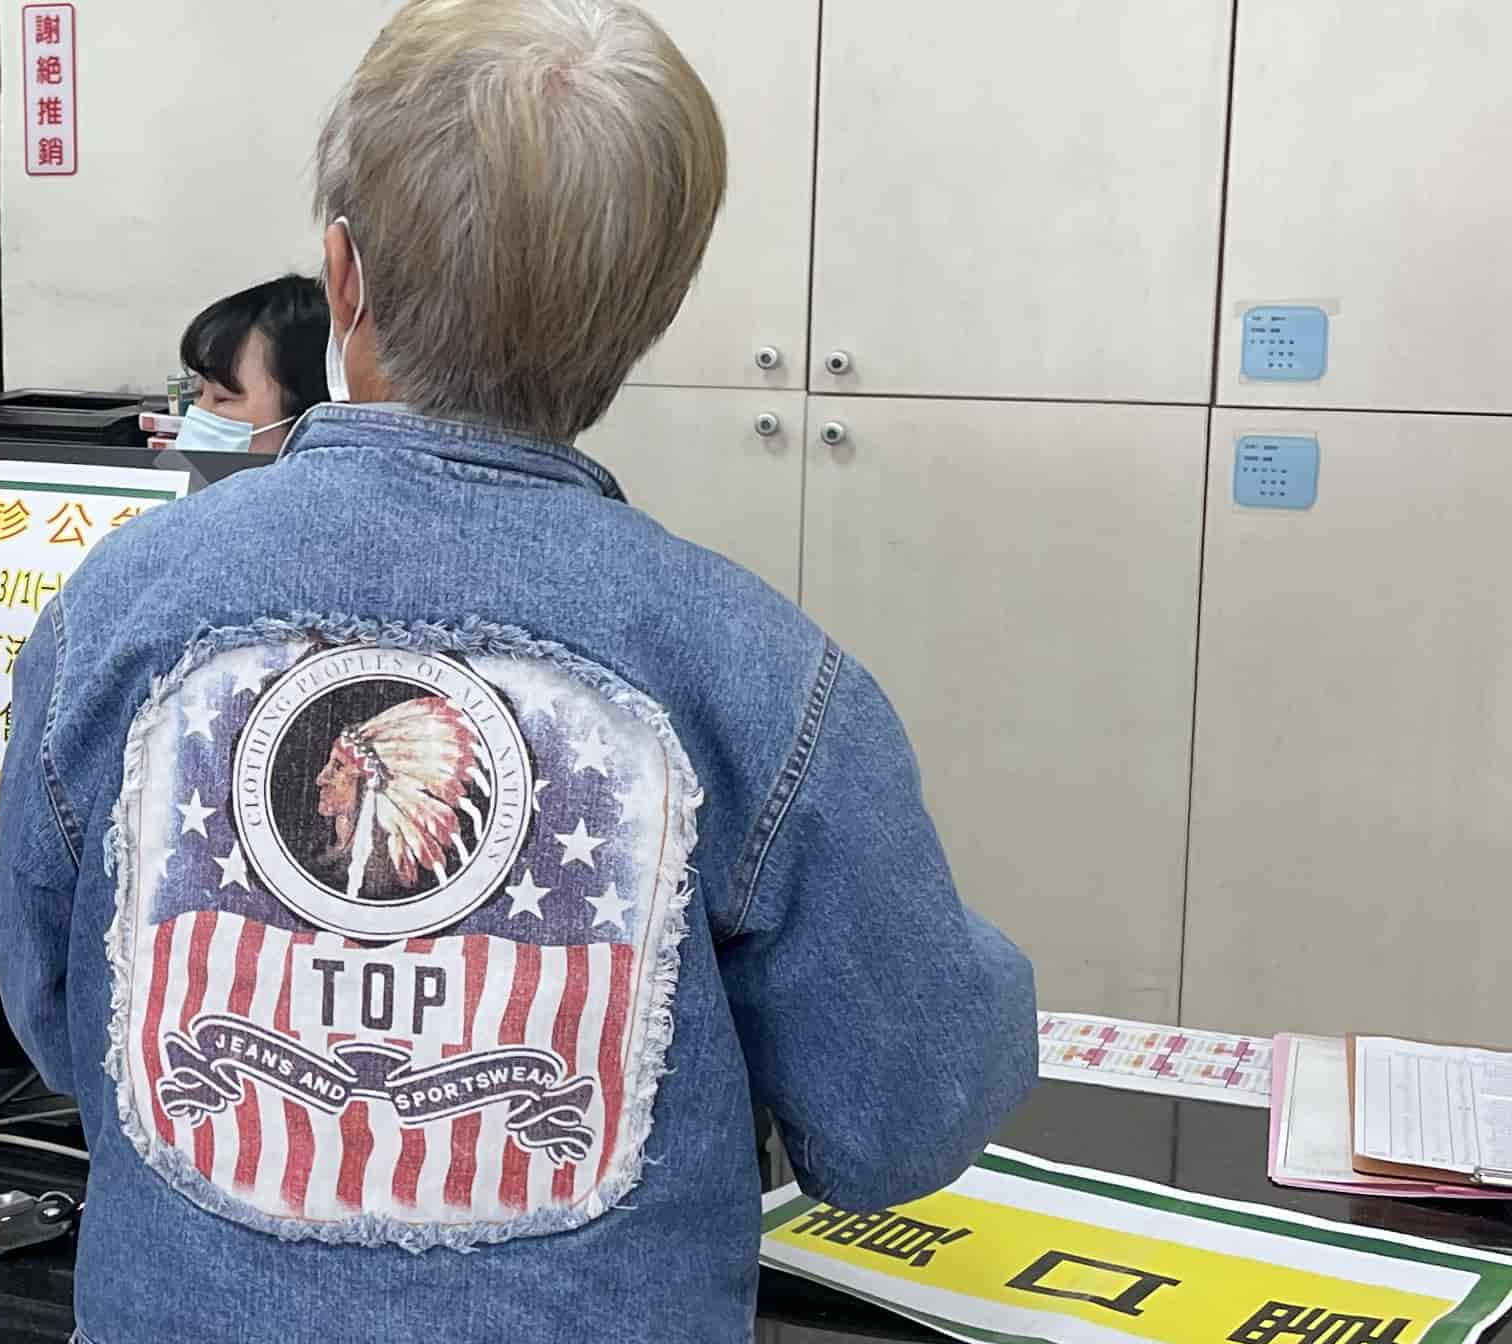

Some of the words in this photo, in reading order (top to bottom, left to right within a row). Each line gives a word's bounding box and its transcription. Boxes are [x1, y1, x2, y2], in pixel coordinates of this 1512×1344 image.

[35, 15, 64, 167] 謝絕推銷
[243, 692, 294, 828] CLOTHING
[295, 654, 403, 696] PEOPLES
[417, 655, 445, 684] OF
[486, 744, 520, 865] NATIONS
[311, 958, 447, 1035] TOP
[214, 1033, 295, 1078] JEANS
[299, 1067, 348, 1103] AND
[393, 1064, 557, 1113] SPORTSWEAR
